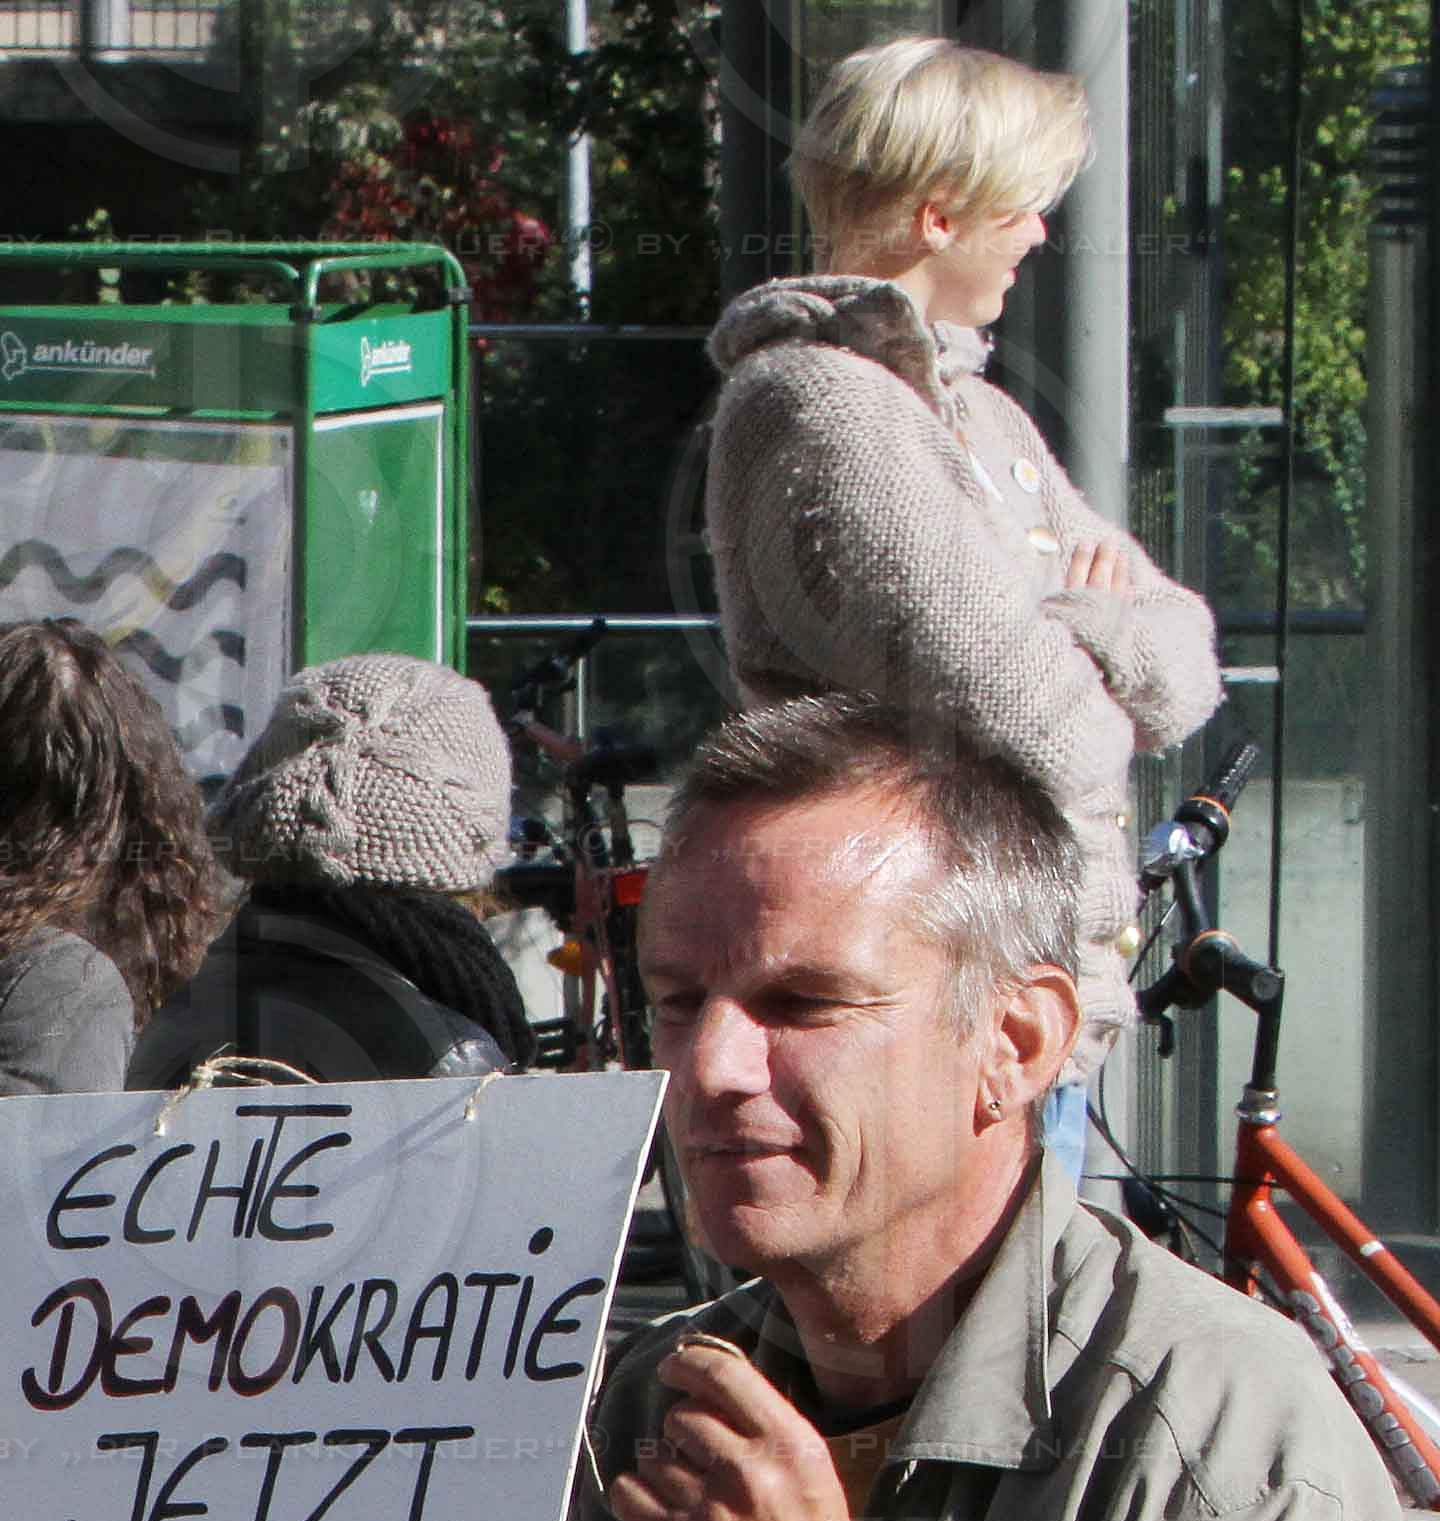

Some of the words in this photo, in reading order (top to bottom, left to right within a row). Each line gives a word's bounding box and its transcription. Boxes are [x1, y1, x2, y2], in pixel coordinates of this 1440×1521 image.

[32, 339, 153, 366] ankünder
[46, 1104, 353, 1251] ECHTE
[21, 1226, 607, 1411] DEMOKRATIE
